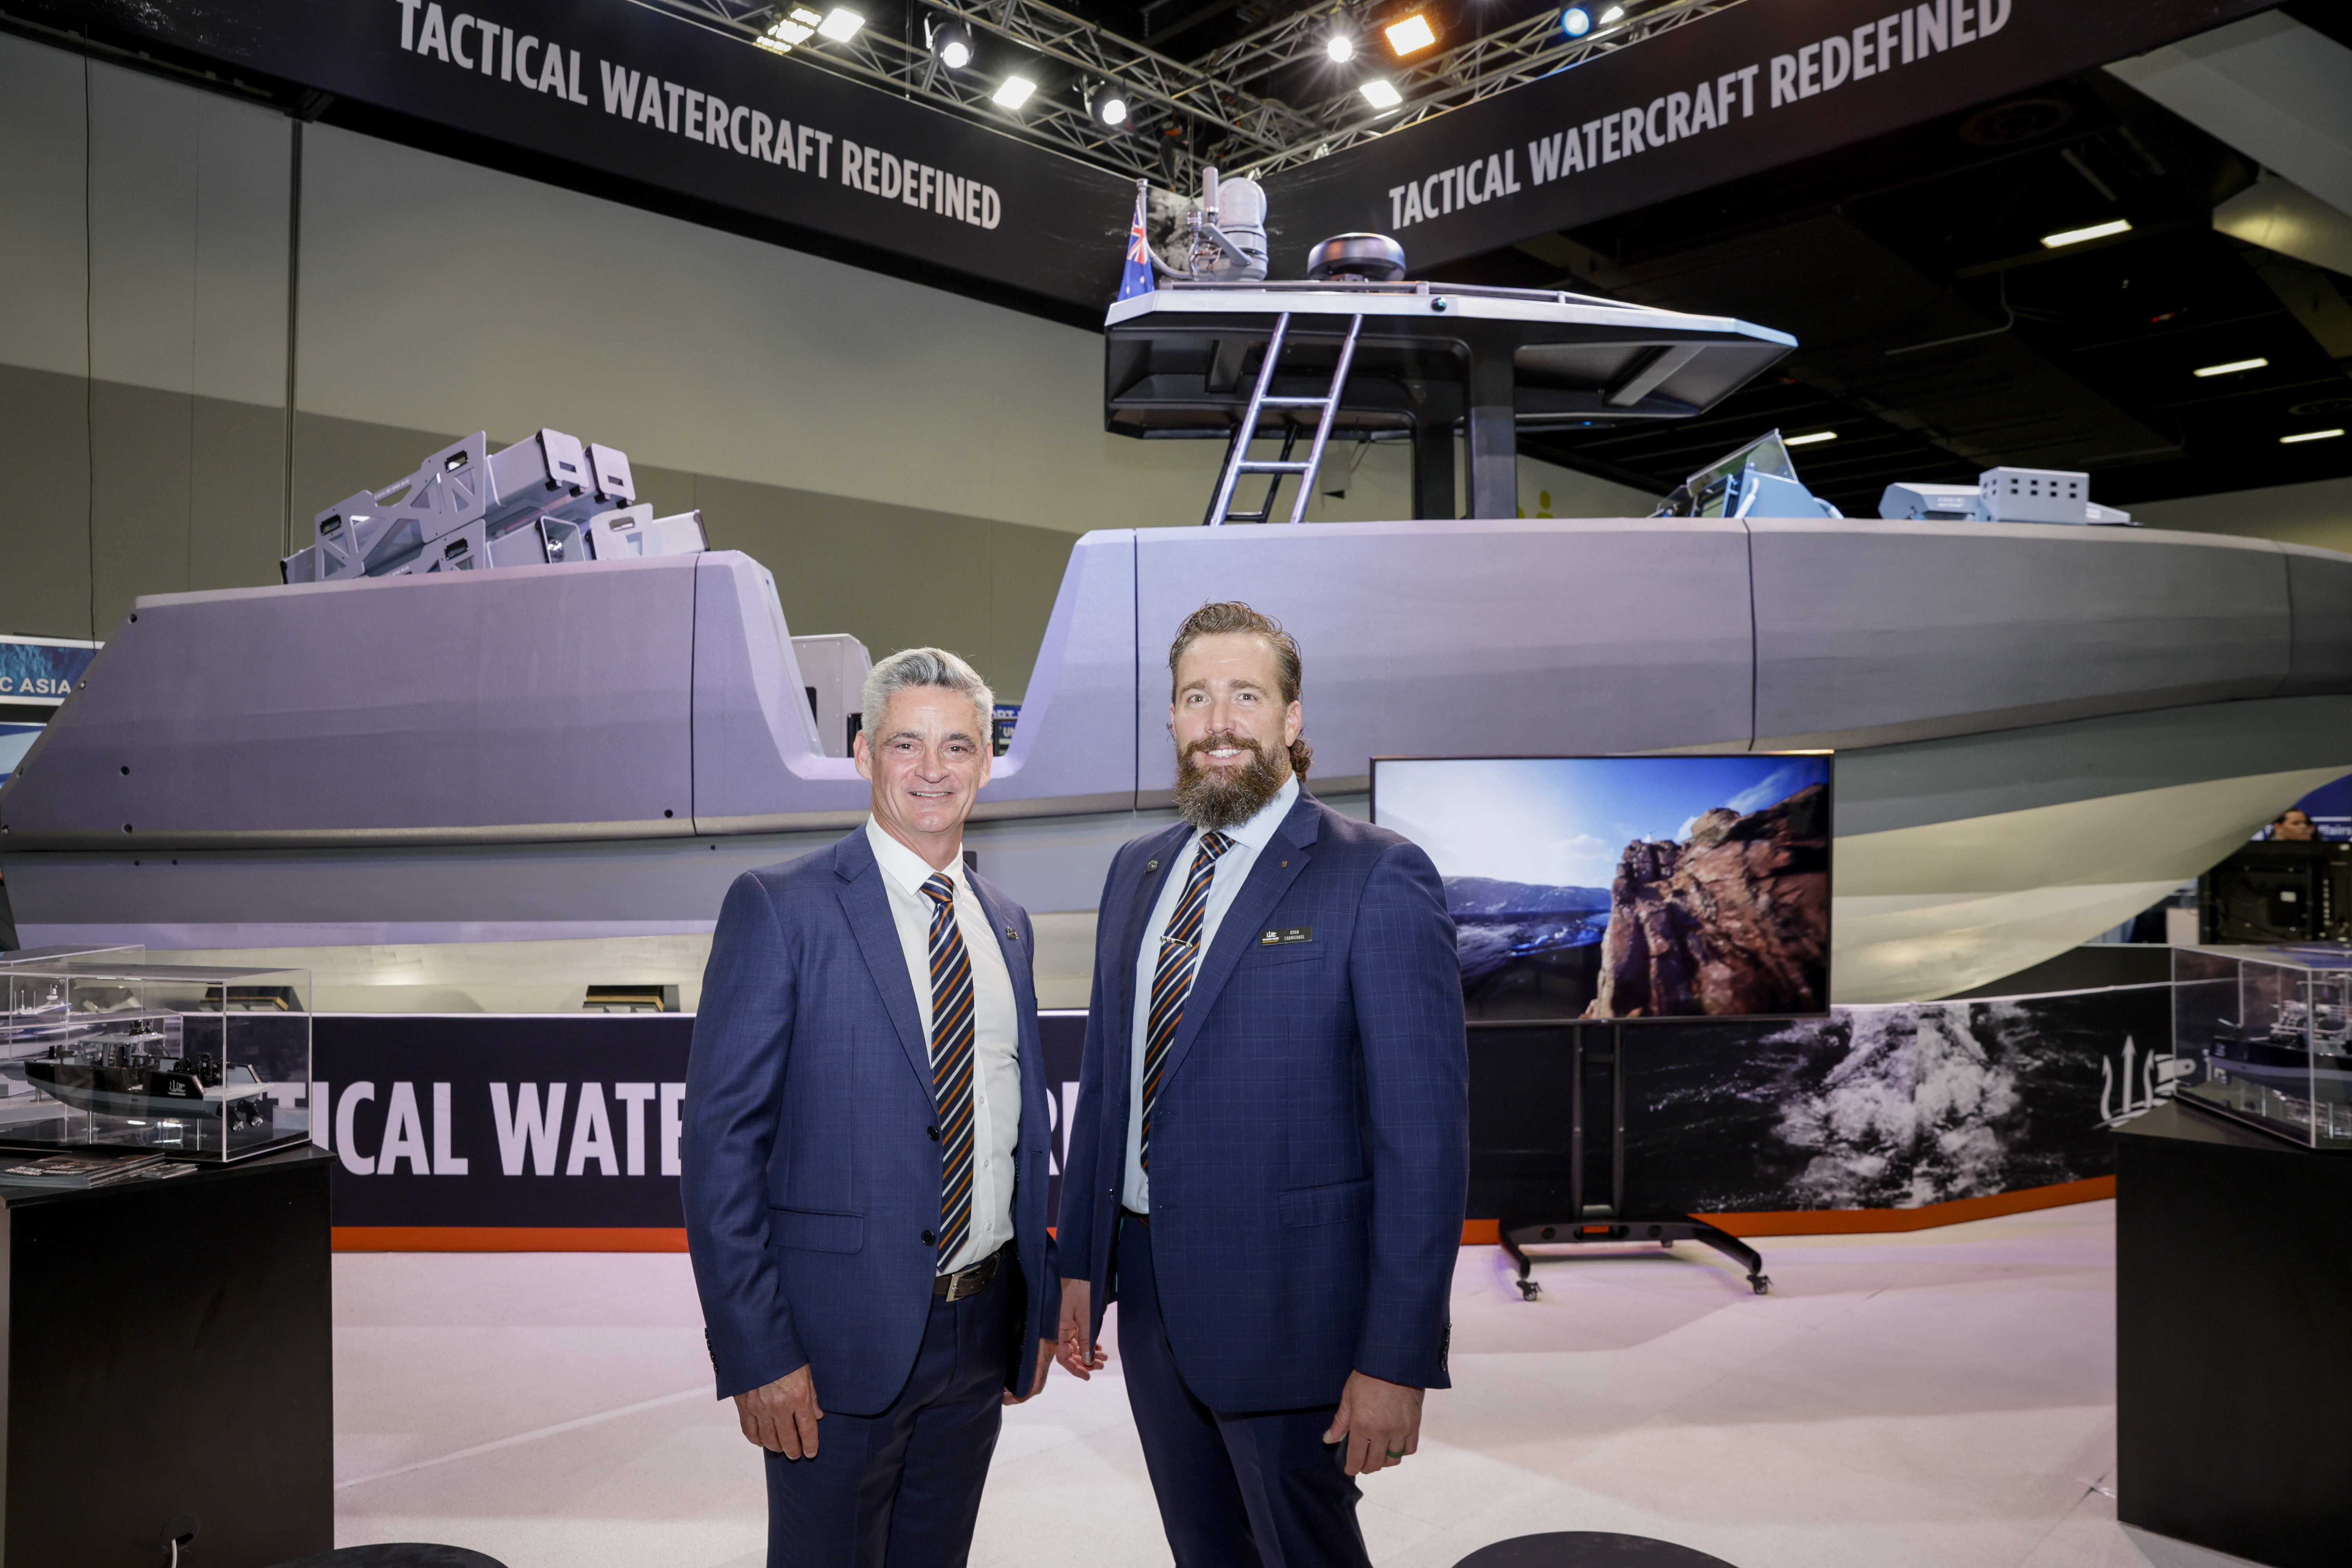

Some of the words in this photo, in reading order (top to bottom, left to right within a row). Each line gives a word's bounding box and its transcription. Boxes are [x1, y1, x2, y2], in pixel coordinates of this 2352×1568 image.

[396, 0, 588, 105] TACTICAL
[600, 60, 833, 179] WATERCRAFT
[842, 139, 1001, 230] REDEFINED
[1388, 149, 1521, 230] TACTICAL
[1528, 64, 1759, 186] WATERCRAFT
[1770, 0, 2012, 109] REDEFINED
[20, 677, 71, 694] ASIA
[259, 1082, 468, 1175] TICAL
